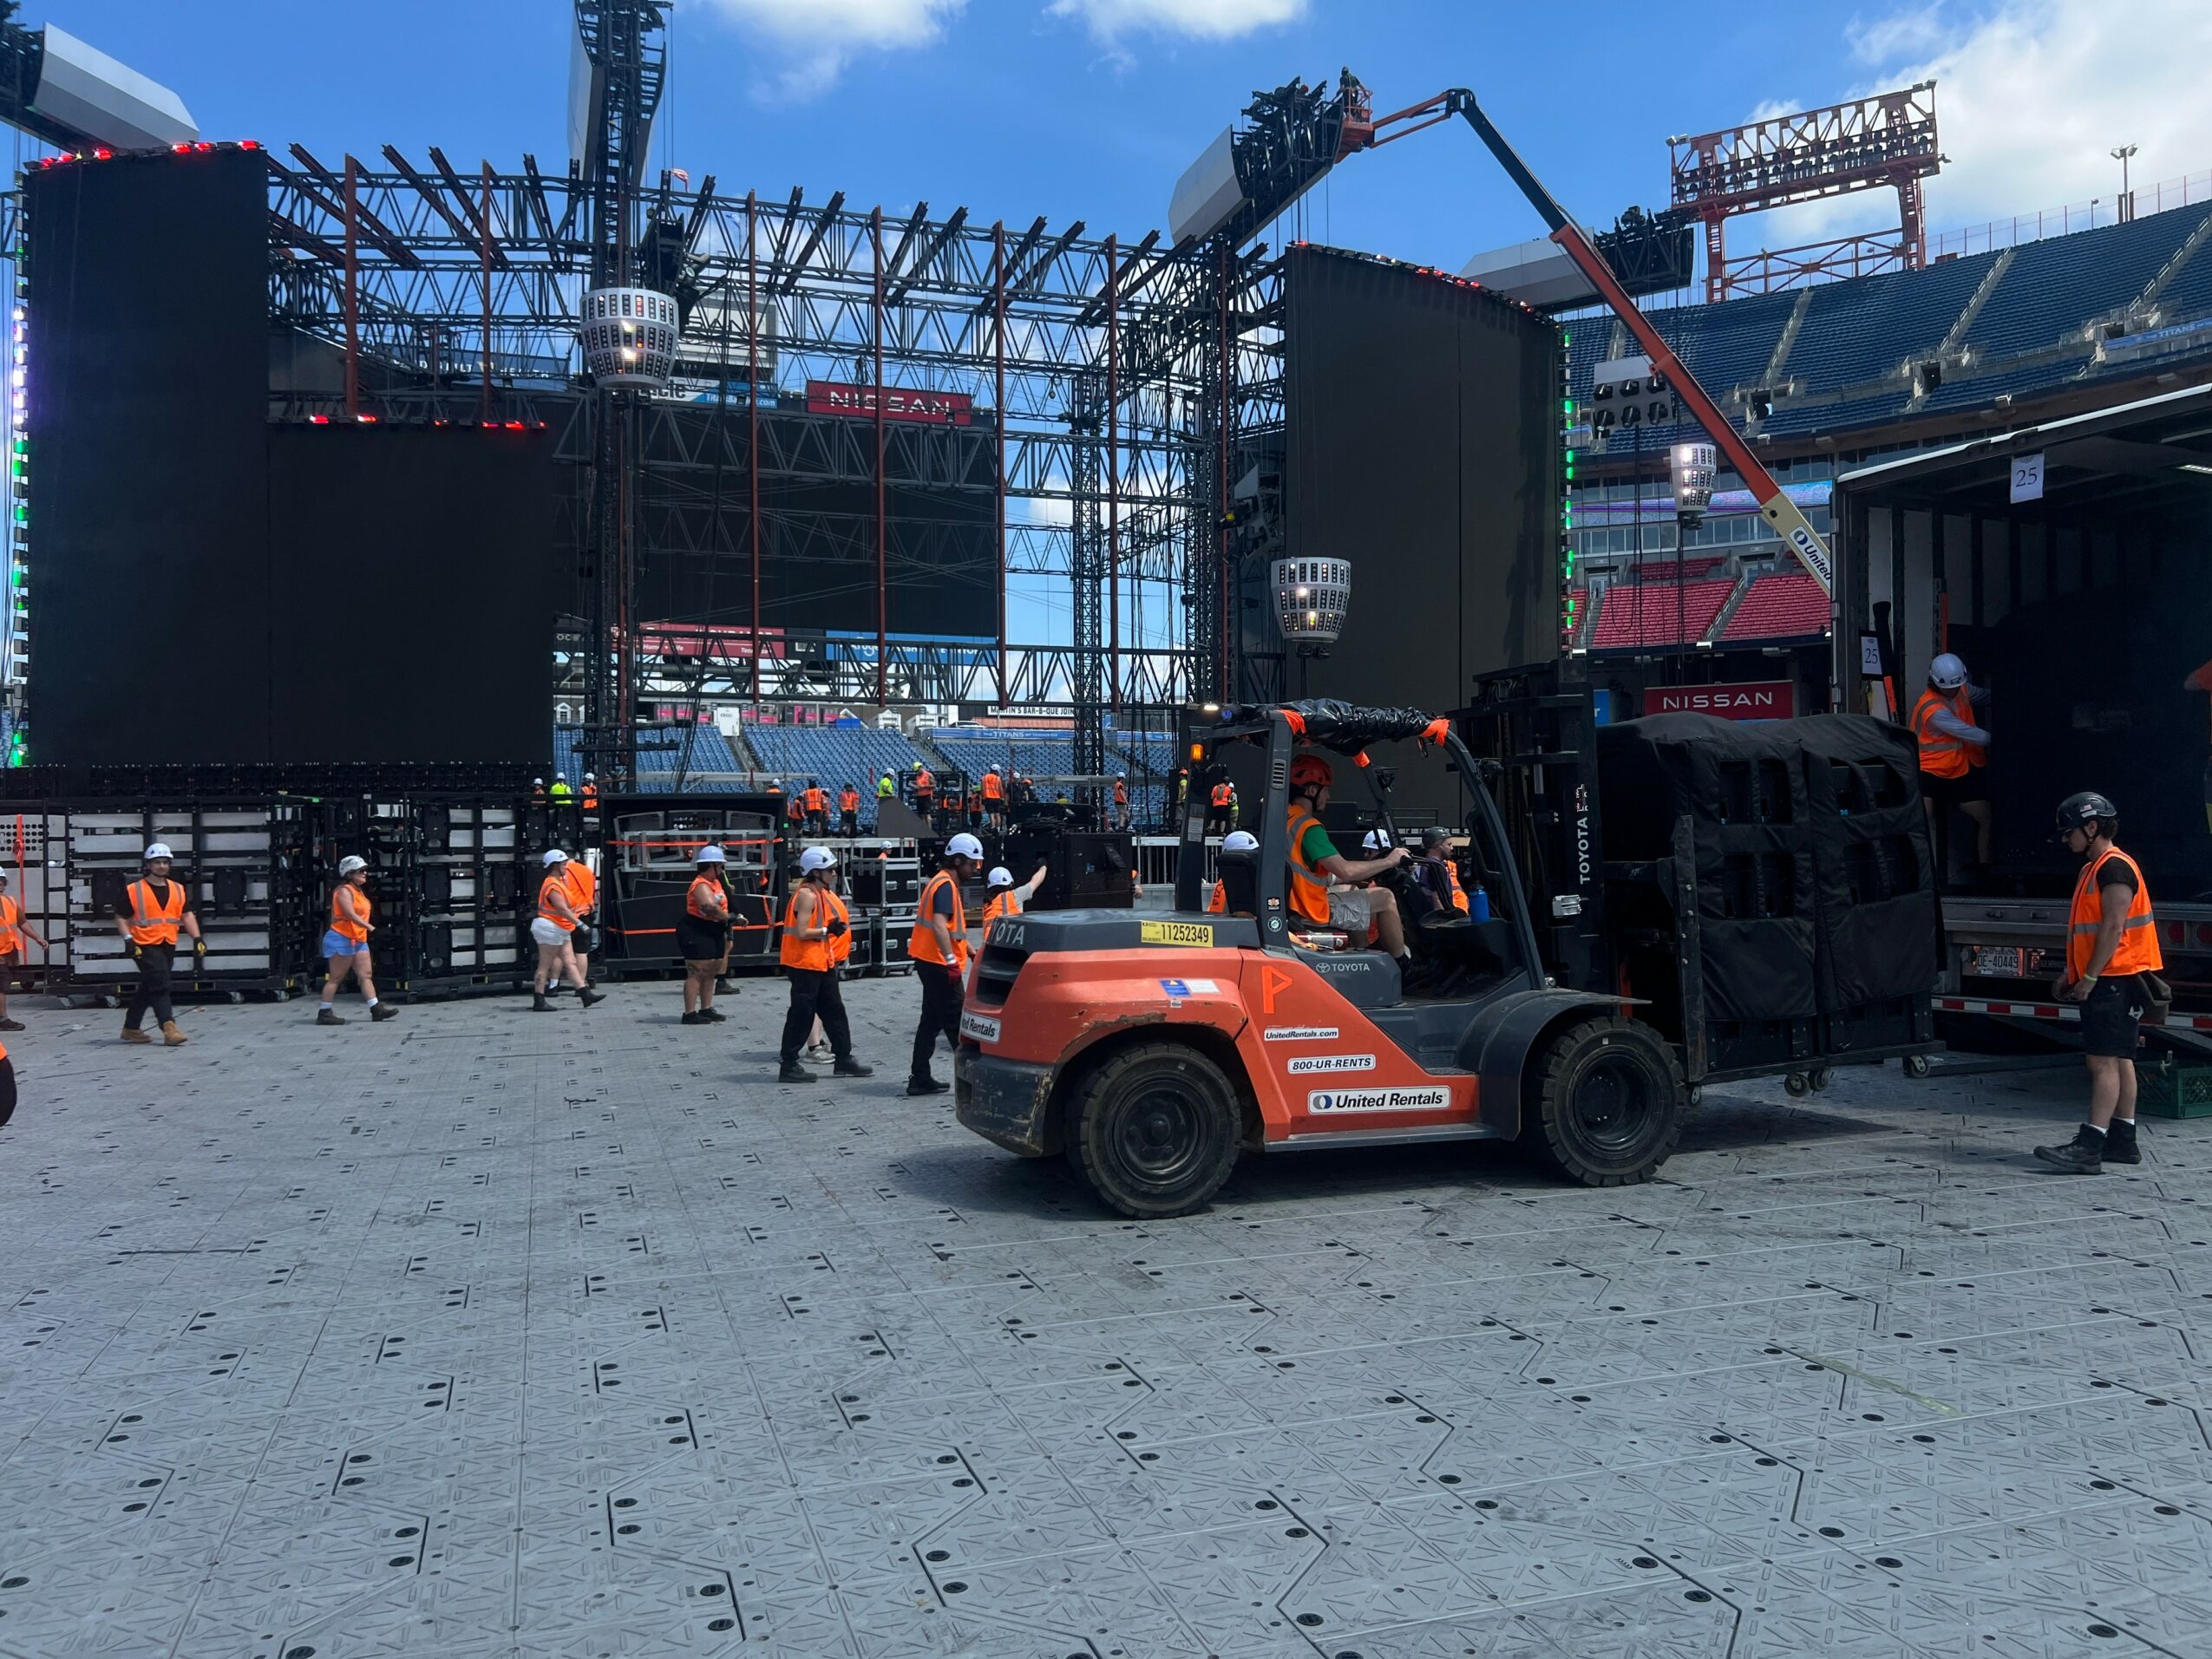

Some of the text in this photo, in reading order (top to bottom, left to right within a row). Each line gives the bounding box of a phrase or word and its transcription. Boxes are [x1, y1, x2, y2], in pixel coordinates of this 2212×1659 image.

[2158, 323, 2196, 337] TITANS
[830, 391, 950, 415] NISSAN
[2015, 467, 2038, 487] 25
[1865, 648, 1878, 664] 25
[1663, 692, 1772, 709] NISSAN
[1577, 817, 1591, 885] TOYOTA
[1162, 924, 1209, 944] 11252349
[1262, 965, 1293, 1014] P
[969, 1019, 996, 1038] Rentals
[1266, 1029, 1338, 1040] UnitedRentals.com
[1293, 1058, 1371, 1071] 800-UR-RENTS
[1336, 1091, 1443, 1109] United Rentals
